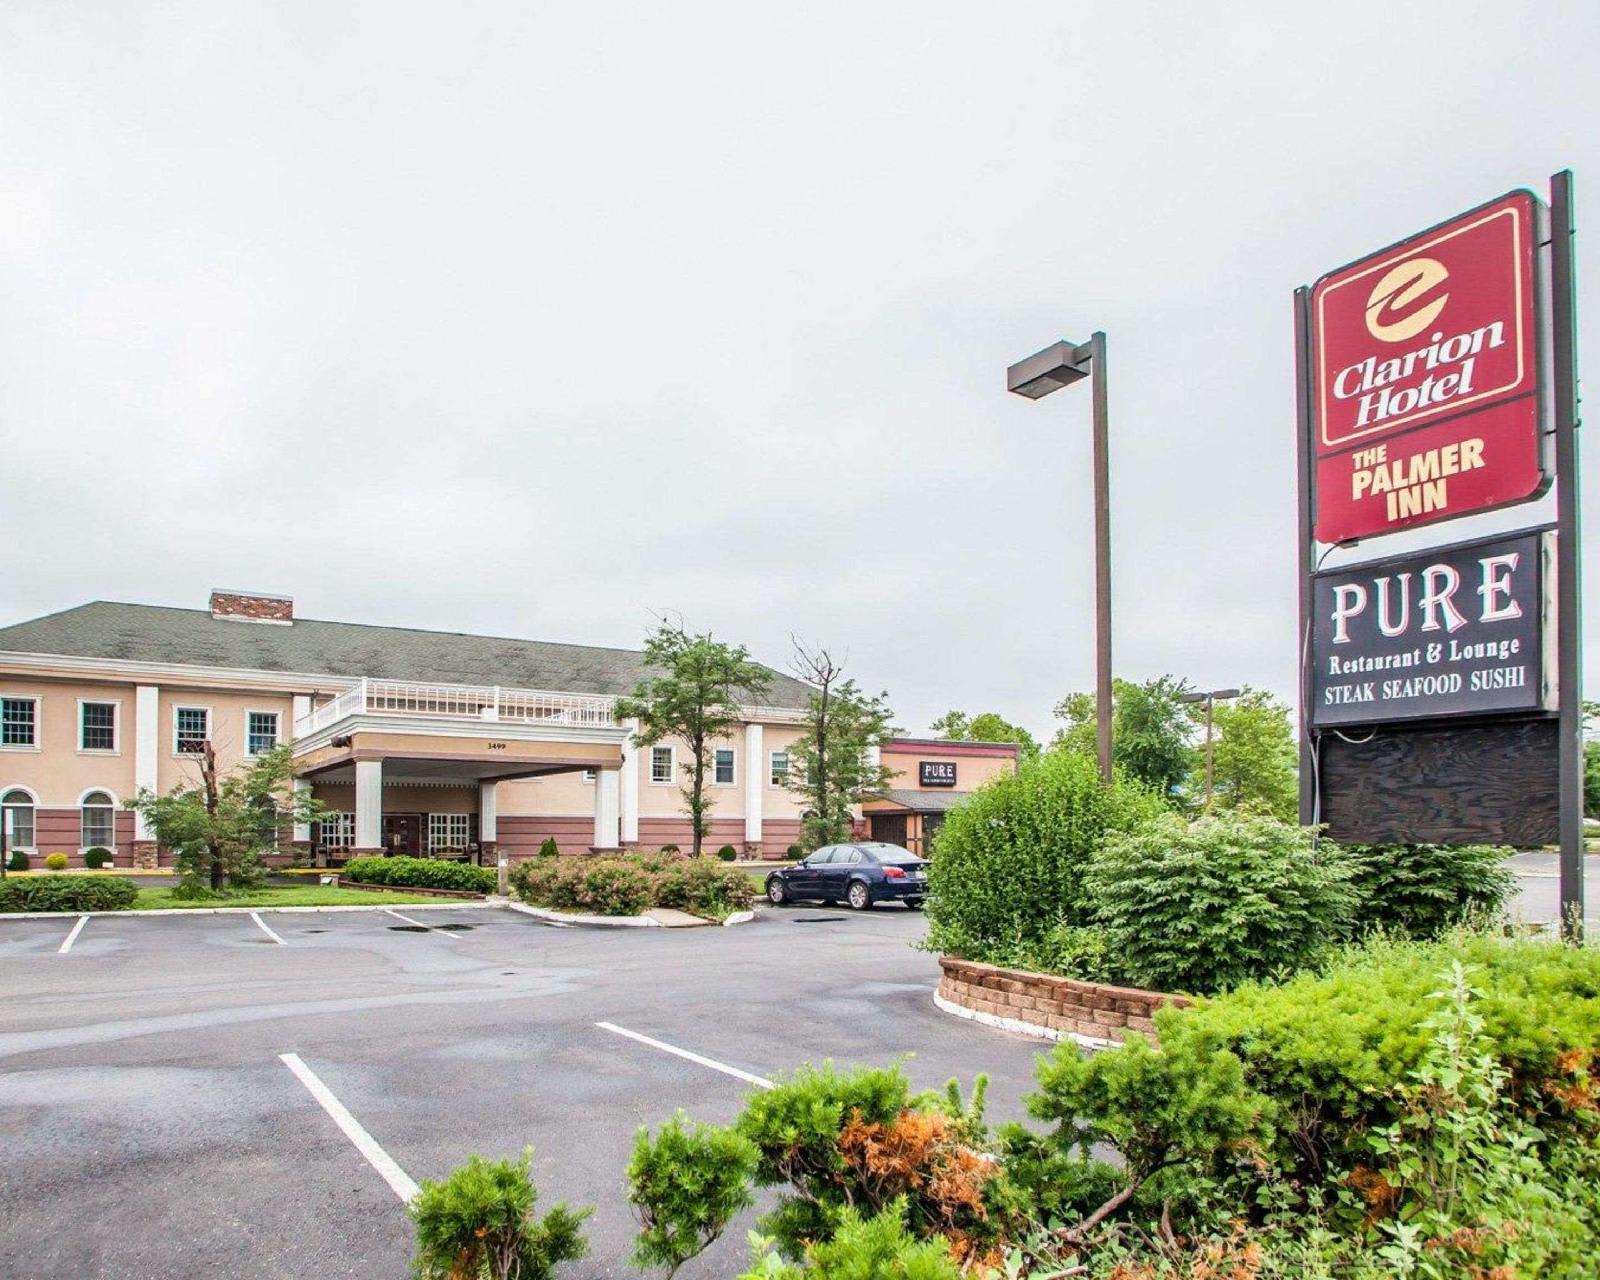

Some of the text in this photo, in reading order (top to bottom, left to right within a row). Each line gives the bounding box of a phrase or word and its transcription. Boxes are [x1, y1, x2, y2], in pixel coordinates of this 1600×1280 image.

[1333, 321, 1506, 400] Clarion
[1353, 358, 1477, 428] Hotel
[1352, 444, 1387, 470] THE
[1352, 437, 1486, 501] PALMER
[1386, 480, 1448, 522] INN
[1331, 552, 1523, 645] PURE
[1329, 638, 1520, 675] Restaurant & Lounge
[1325, 665, 1525, 705] STEAK SEAFOOD SUSHI
[925, 764, 954, 777] PURE
